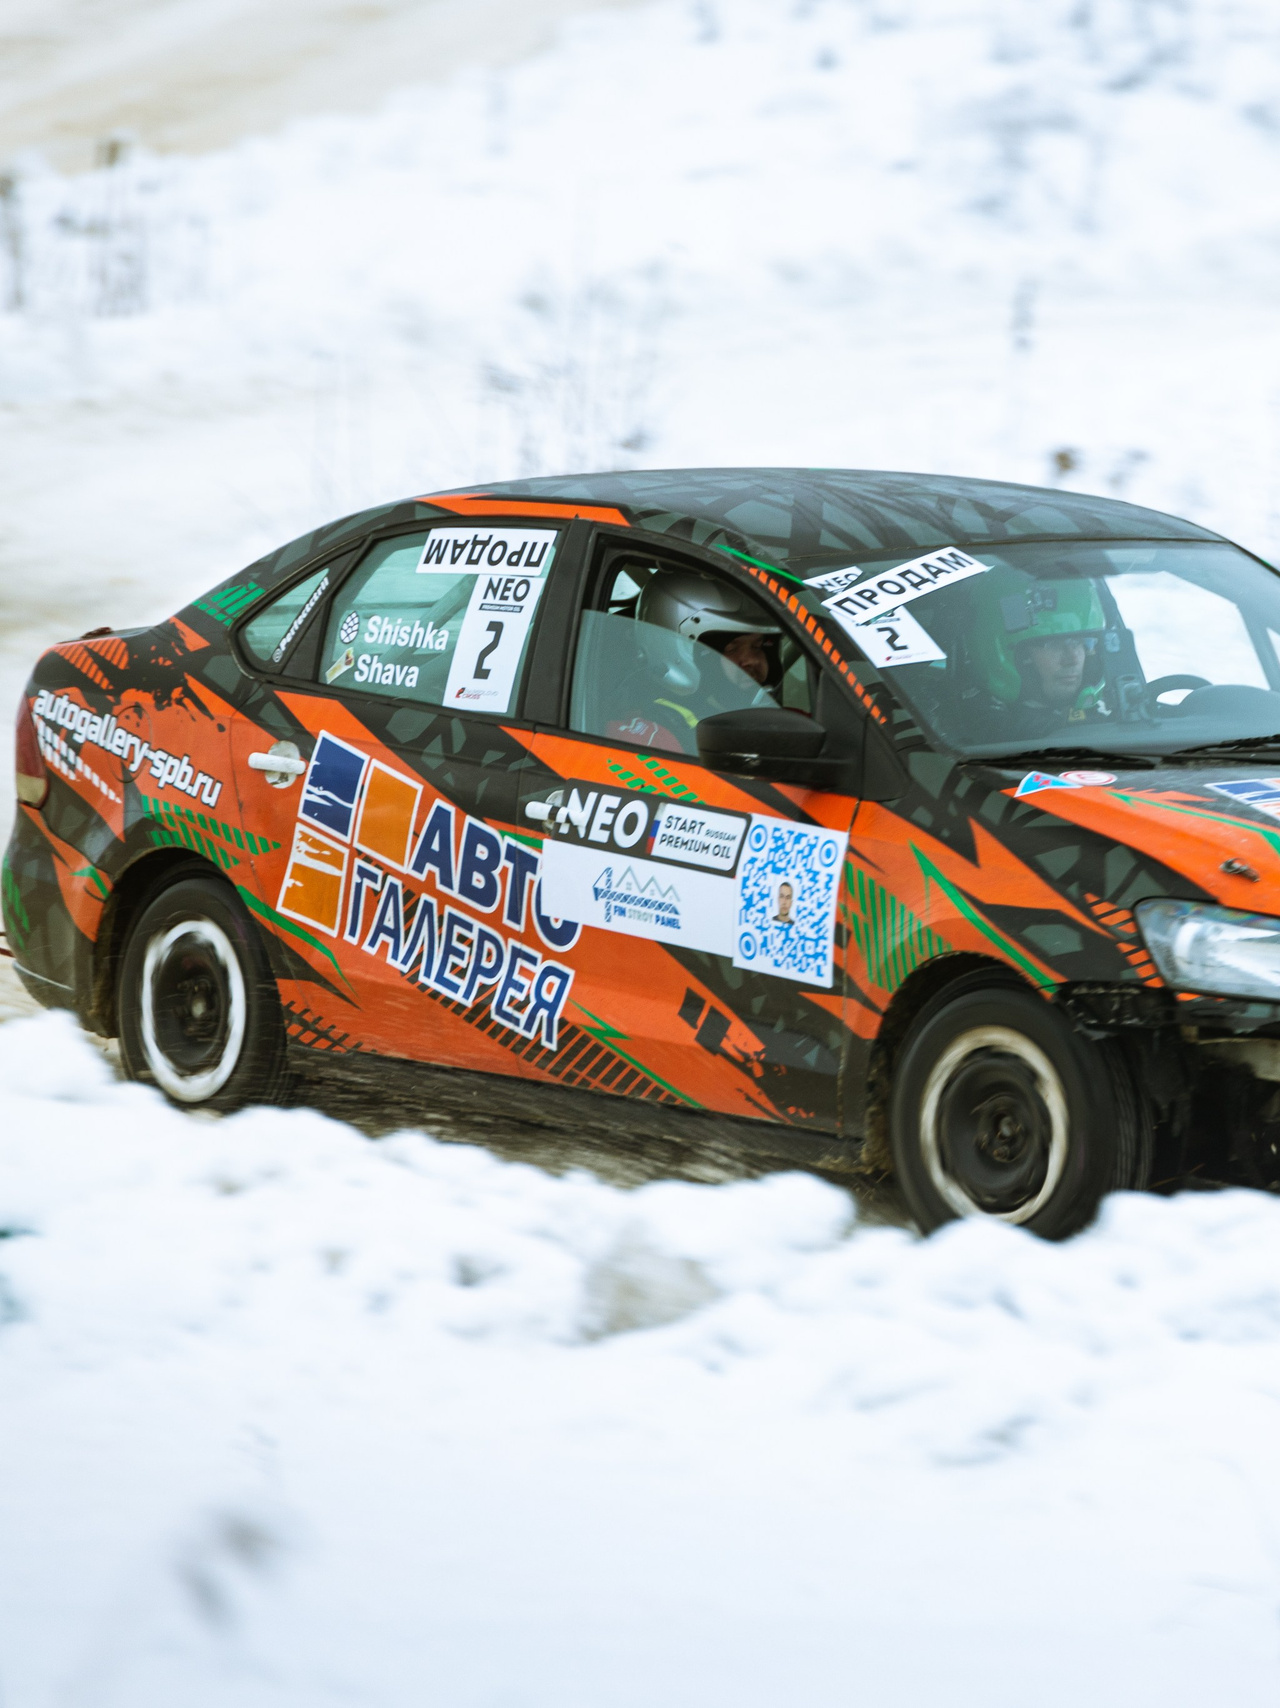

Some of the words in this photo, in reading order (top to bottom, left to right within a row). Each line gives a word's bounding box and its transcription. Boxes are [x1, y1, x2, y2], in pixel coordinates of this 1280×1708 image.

[423, 534, 549, 567] ПРОДАМ
[483, 577, 531, 602] NEO
[833, 552, 974, 616] ПРОДАМ
[364, 615, 449, 650] Shishka
[877, 626, 908, 651] 2
[473, 621, 504, 680] 2
[354, 654, 419, 687] Shava
[33, 689, 222, 808] autogallery-spb.ru
[557, 788, 649, 849] NEO
[665, 815, 706, 835] START
[659, 833, 711, 855] PREMIUM
[712, 844, 731, 859] OIL
[343, 857, 575, 1051] ГАЛЕРЕЯ
